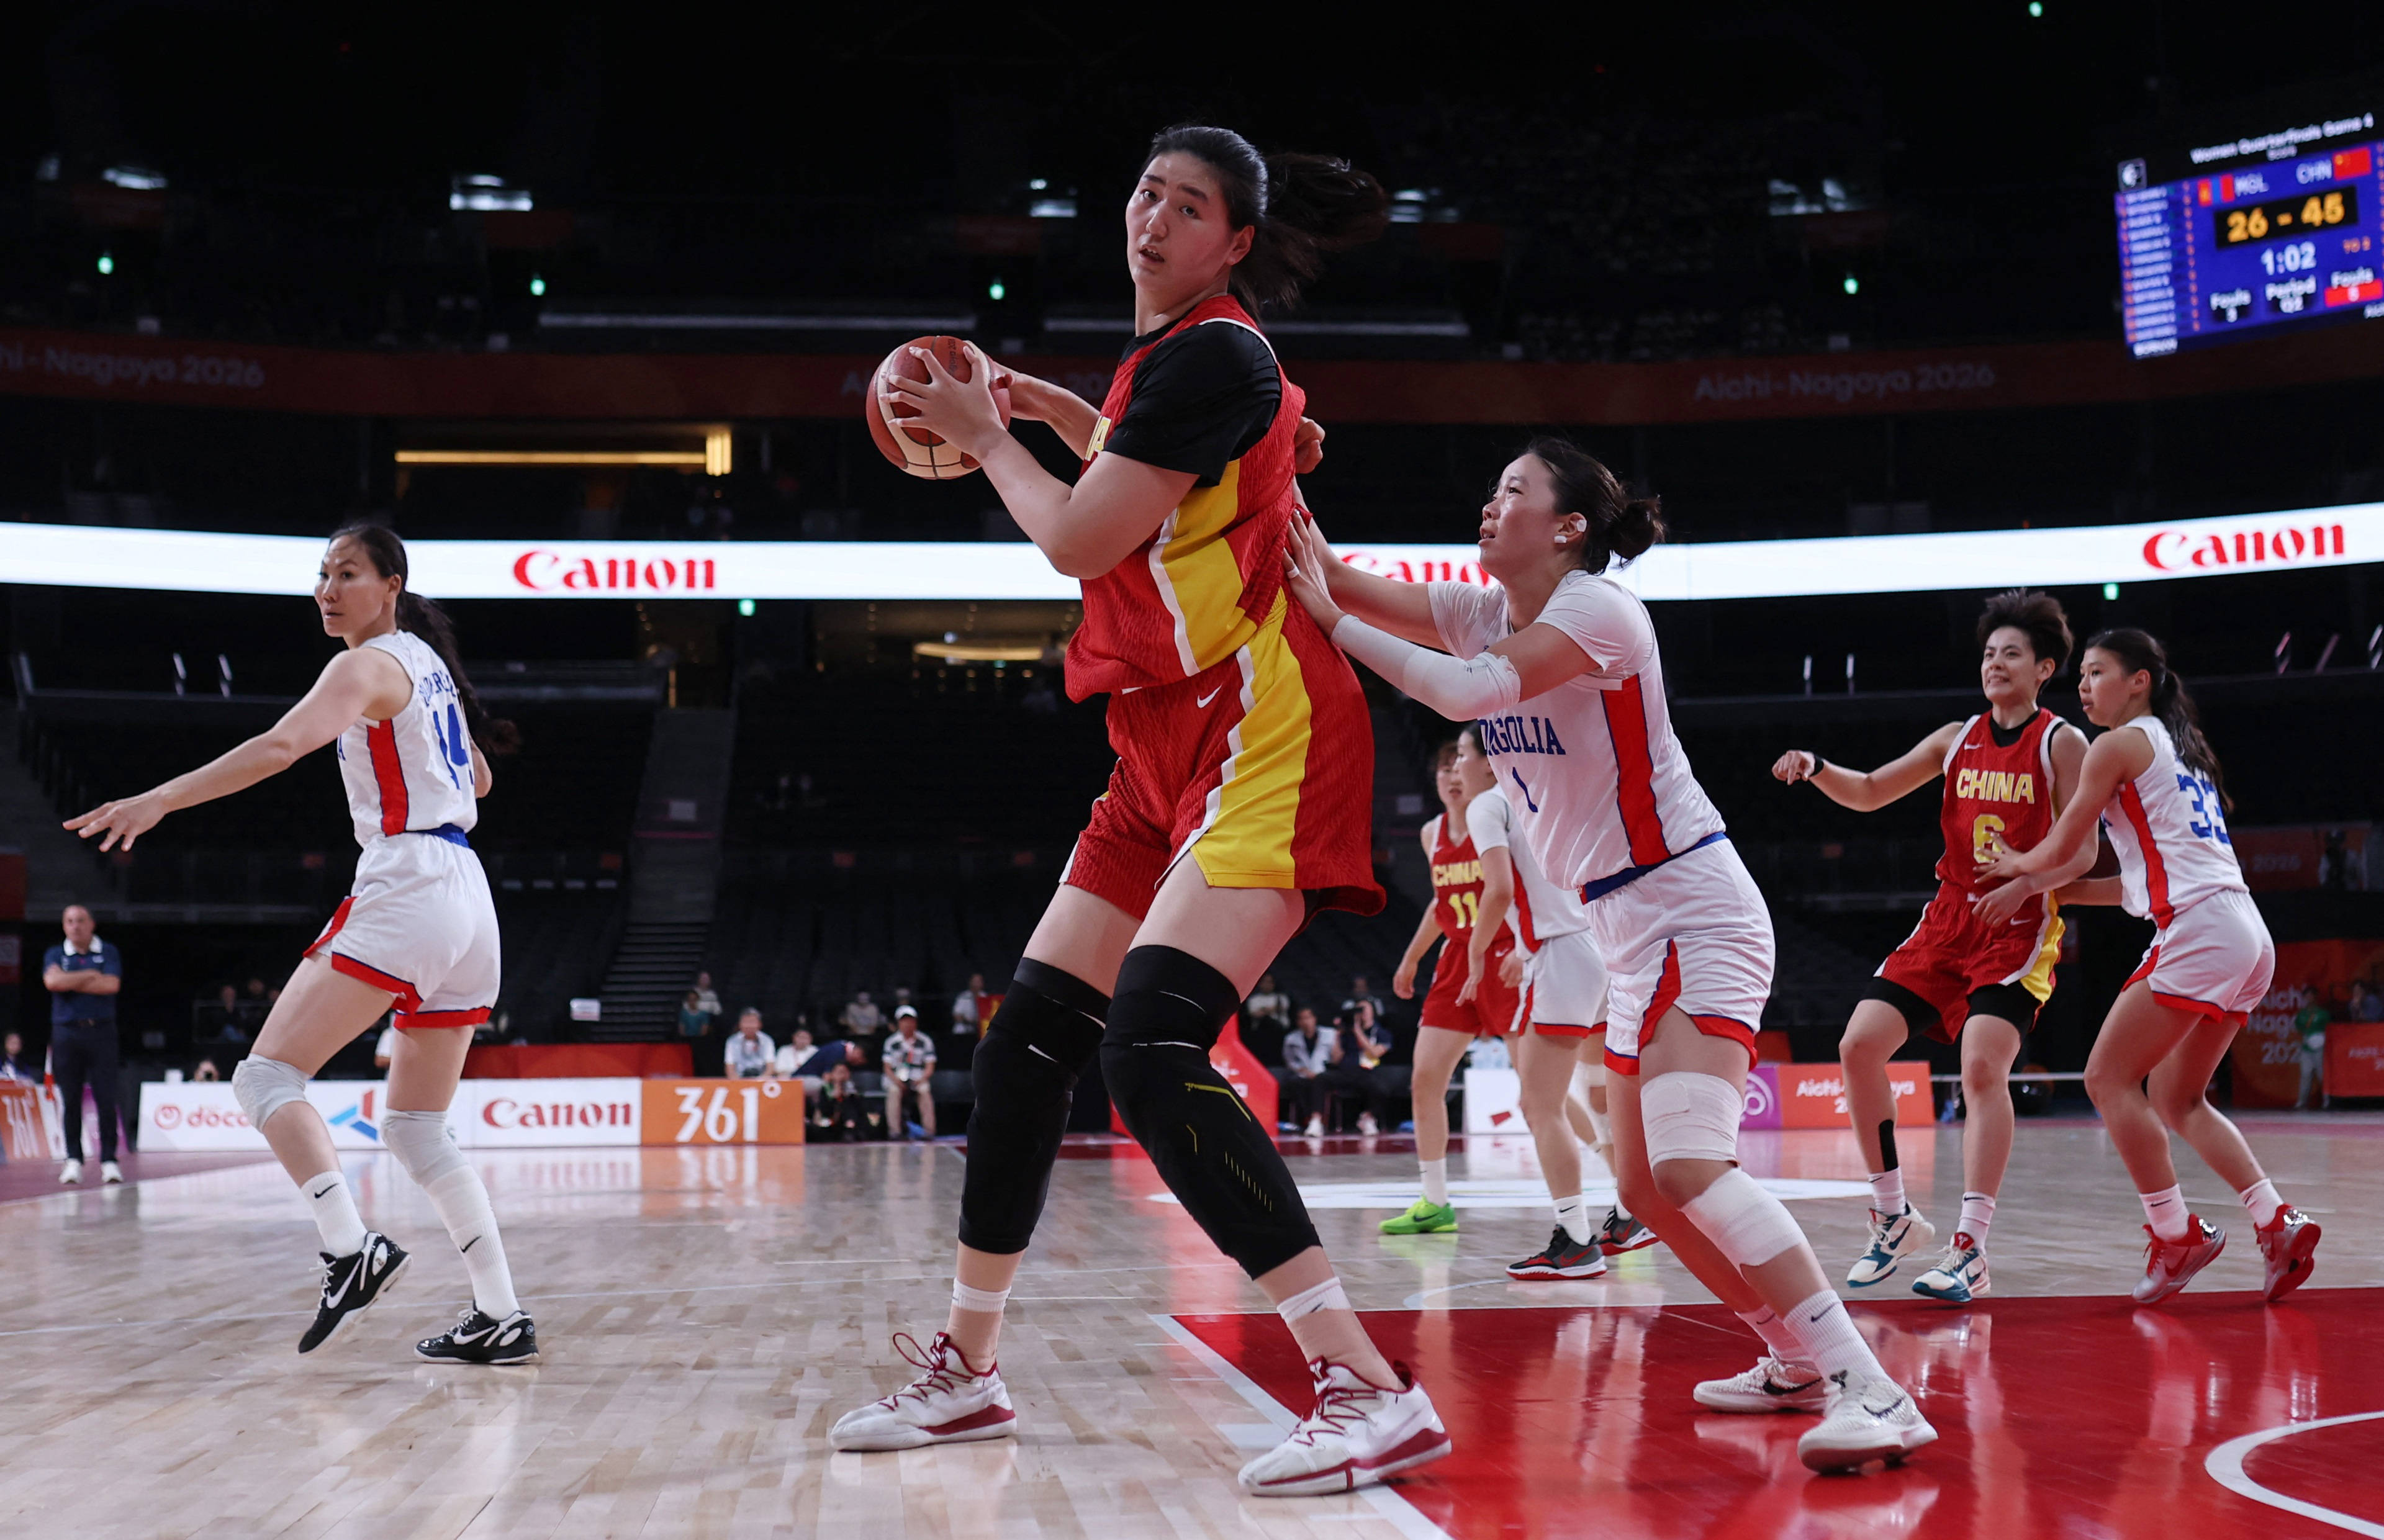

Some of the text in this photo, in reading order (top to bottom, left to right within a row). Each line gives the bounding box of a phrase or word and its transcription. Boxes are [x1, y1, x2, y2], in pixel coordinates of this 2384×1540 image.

[2235, 159, 2332, 197] MGL CHN
[2227, 207, 2269, 243] 26
[2301, 191, 2346, 227] 45
[2260, 241, 2316, 276] 1:02
[2265, 274, 2316, 301] Period
[2331, 266, 2374, 289] Fouls
[183, 353, 266, 389] 2026
[1694, 362, 1997, 403] Aichi-Nagoya 2026
[2143, 525, 2344, 571] Canon
[513, 550, 715, 590] Canon
[433, 703, 474, 790] 14
[1512, 767, 1538, 813] 1
[1956, 767, 2035, 804] CHINA
[1972, 813, 2006, 865] 6
[1432, 860, 1484, 888] CHINA
[1448, 890, 1479, 929] 11
[2261, 1041, 2302, 1065] 202
[187, 1104, 250, 1128] doco
[482, 1098, 632, 1129] Canon
